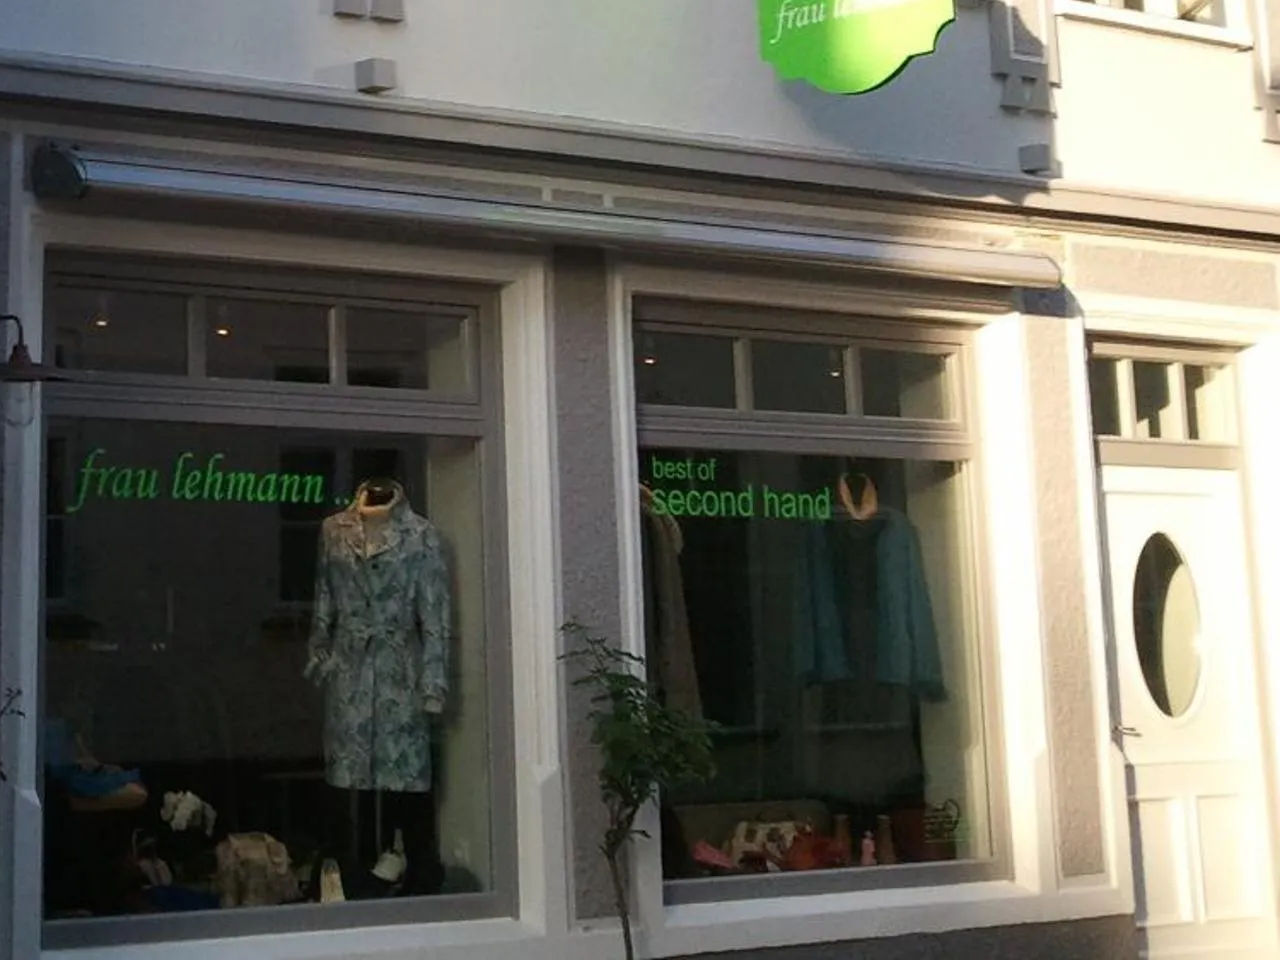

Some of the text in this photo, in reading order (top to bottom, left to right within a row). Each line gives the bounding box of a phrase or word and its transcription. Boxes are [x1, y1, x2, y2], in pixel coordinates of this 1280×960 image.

[65, 448, 159, 512] frau
[172, 452, 324, 504] lehmann
[652, 456, 717, 481] best of
[652, 485, 831, 520] second hand
